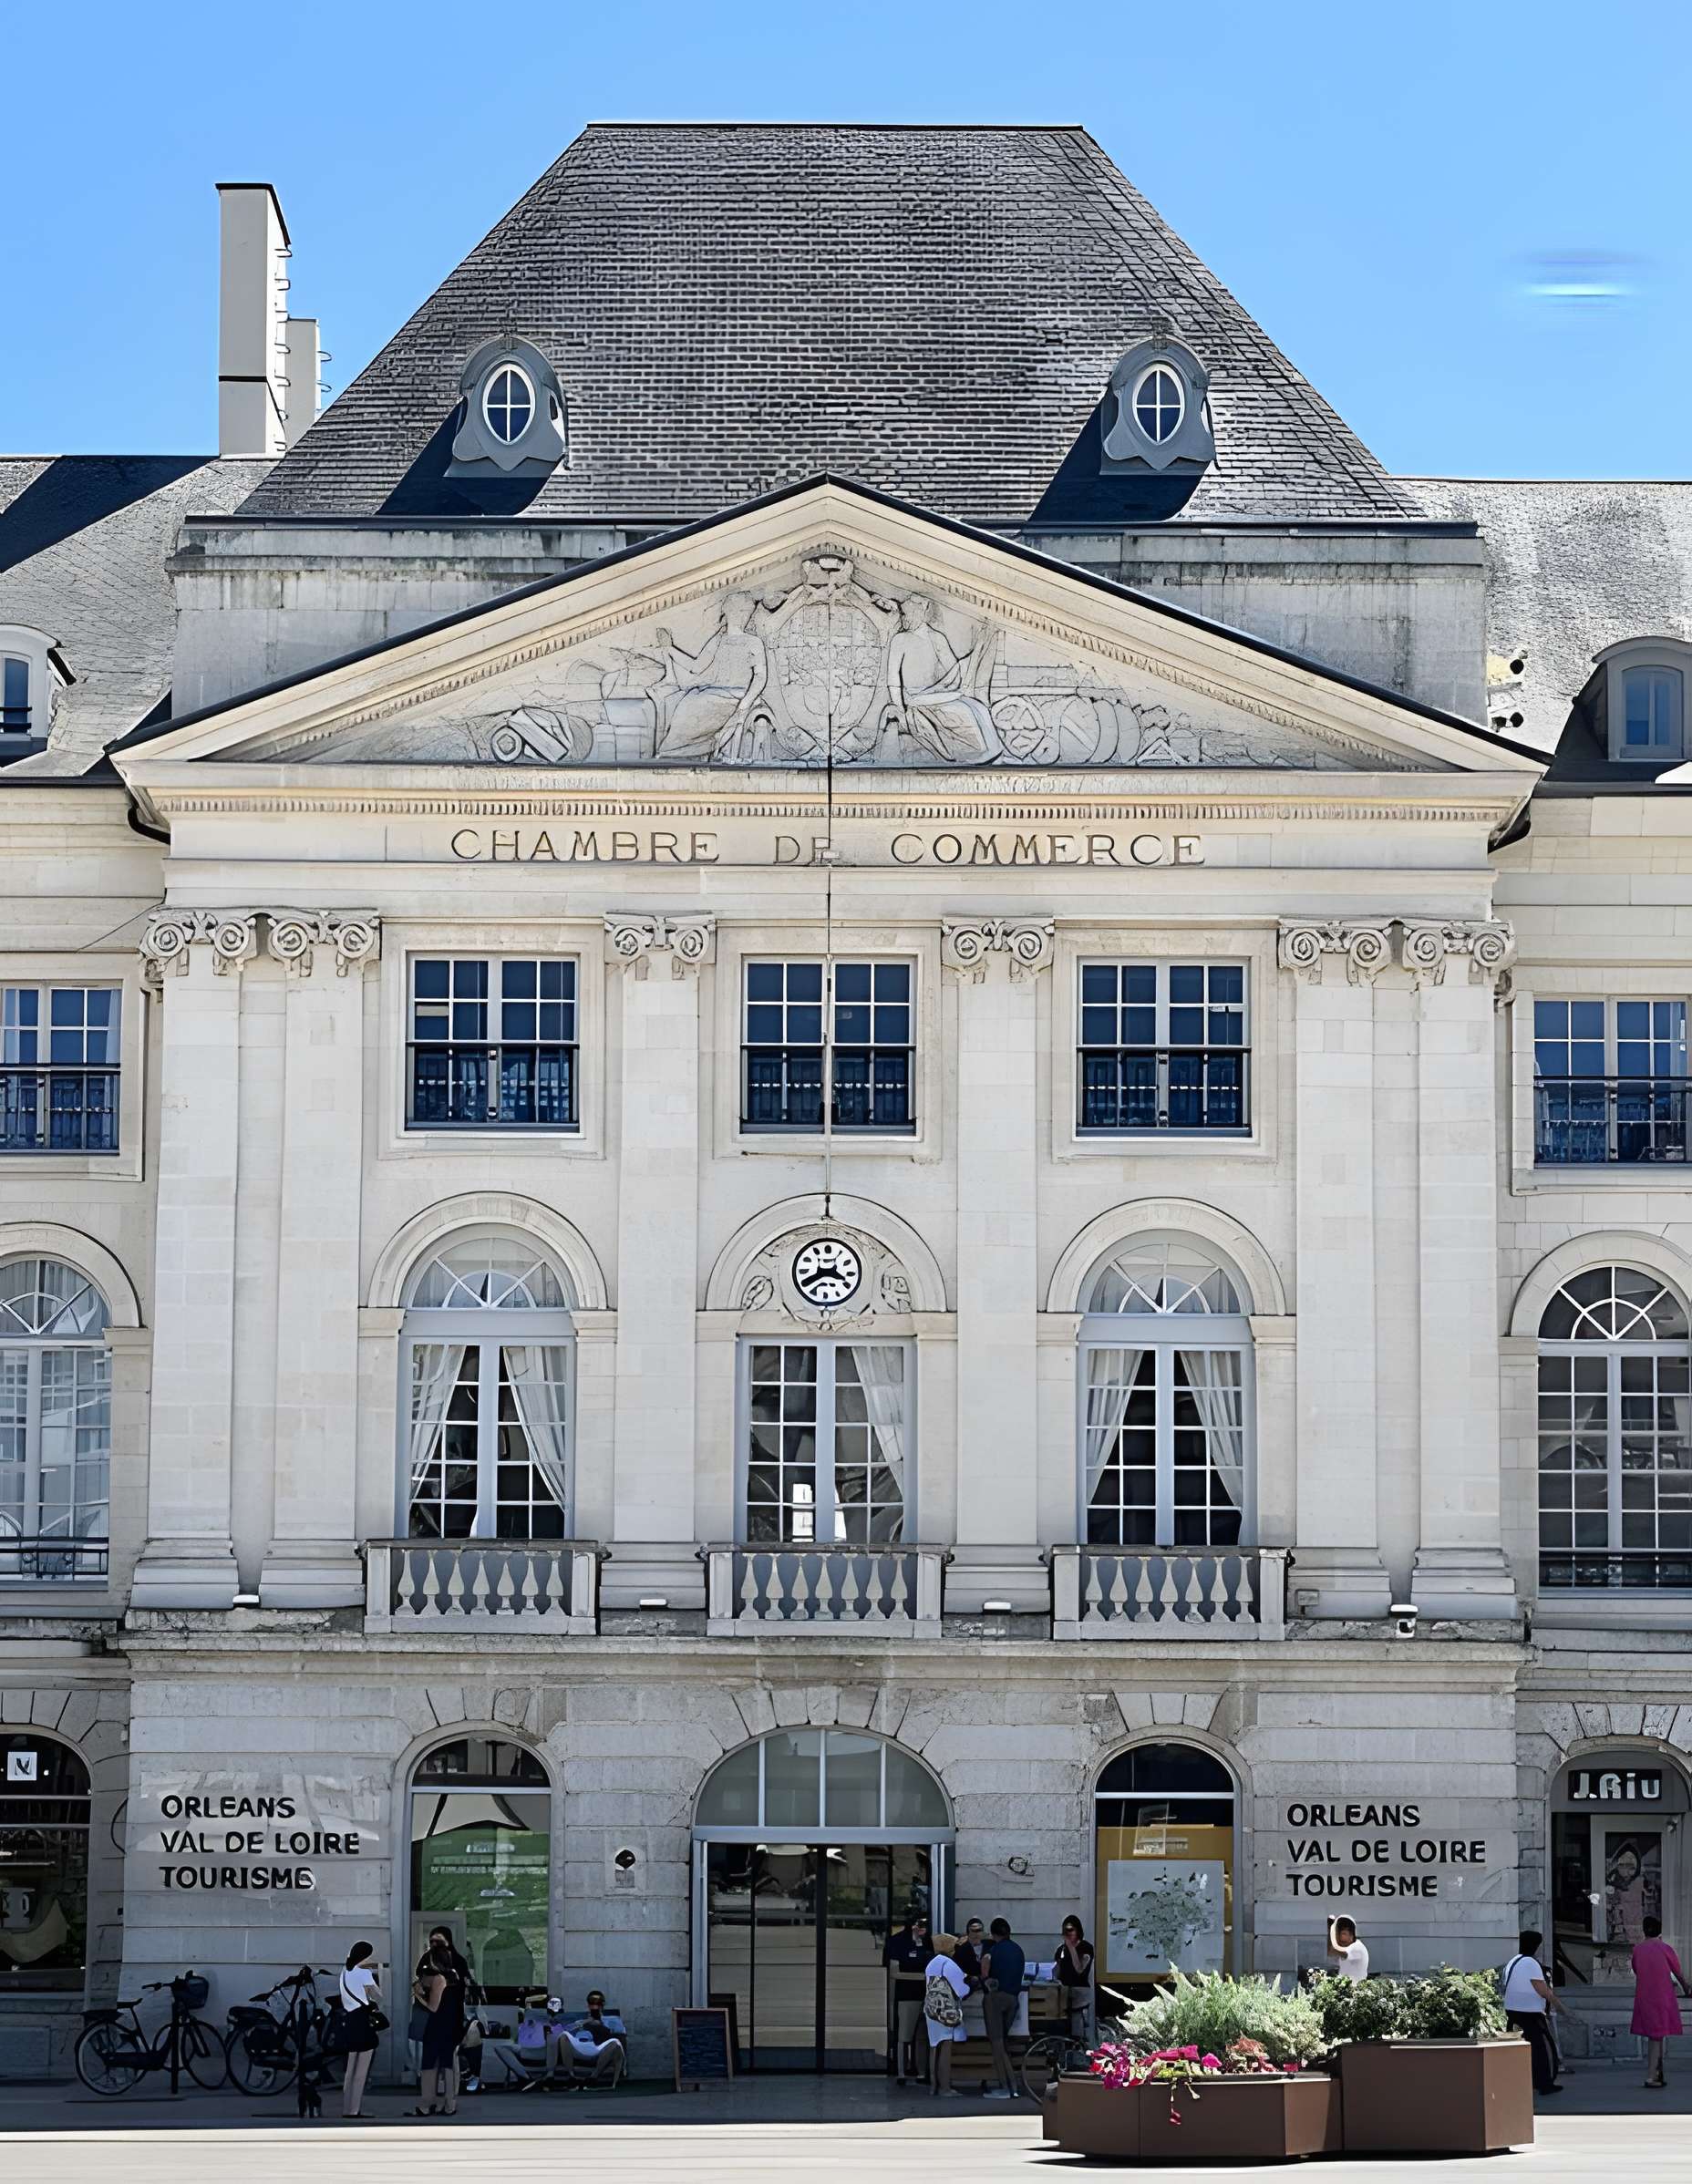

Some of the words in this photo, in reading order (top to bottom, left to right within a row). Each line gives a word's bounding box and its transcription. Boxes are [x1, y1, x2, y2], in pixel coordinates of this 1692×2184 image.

[450, 829, 719, 862] CHAMBRE
[891, 833, 1205, 866] COMMERCE
[160, 1795, 296, 1818] ORLEANS
[1286, 1803, 1421, 1828] ORLEANS
[160, 1830, 214, 1853] VAL
[225, 1831, 264, 1854] DE
[275, 1831, 360, 1855] LOIRE
[1287, 1839, 1341, 1863] VAL
[1351, 1839, 1389, 1863] DE
[1400, 1839, 1486, 1863] LOIRE
[160, 1866, 315, 1890] TOURISME
[1285, 1873, 1438, 1897] TOURISME
